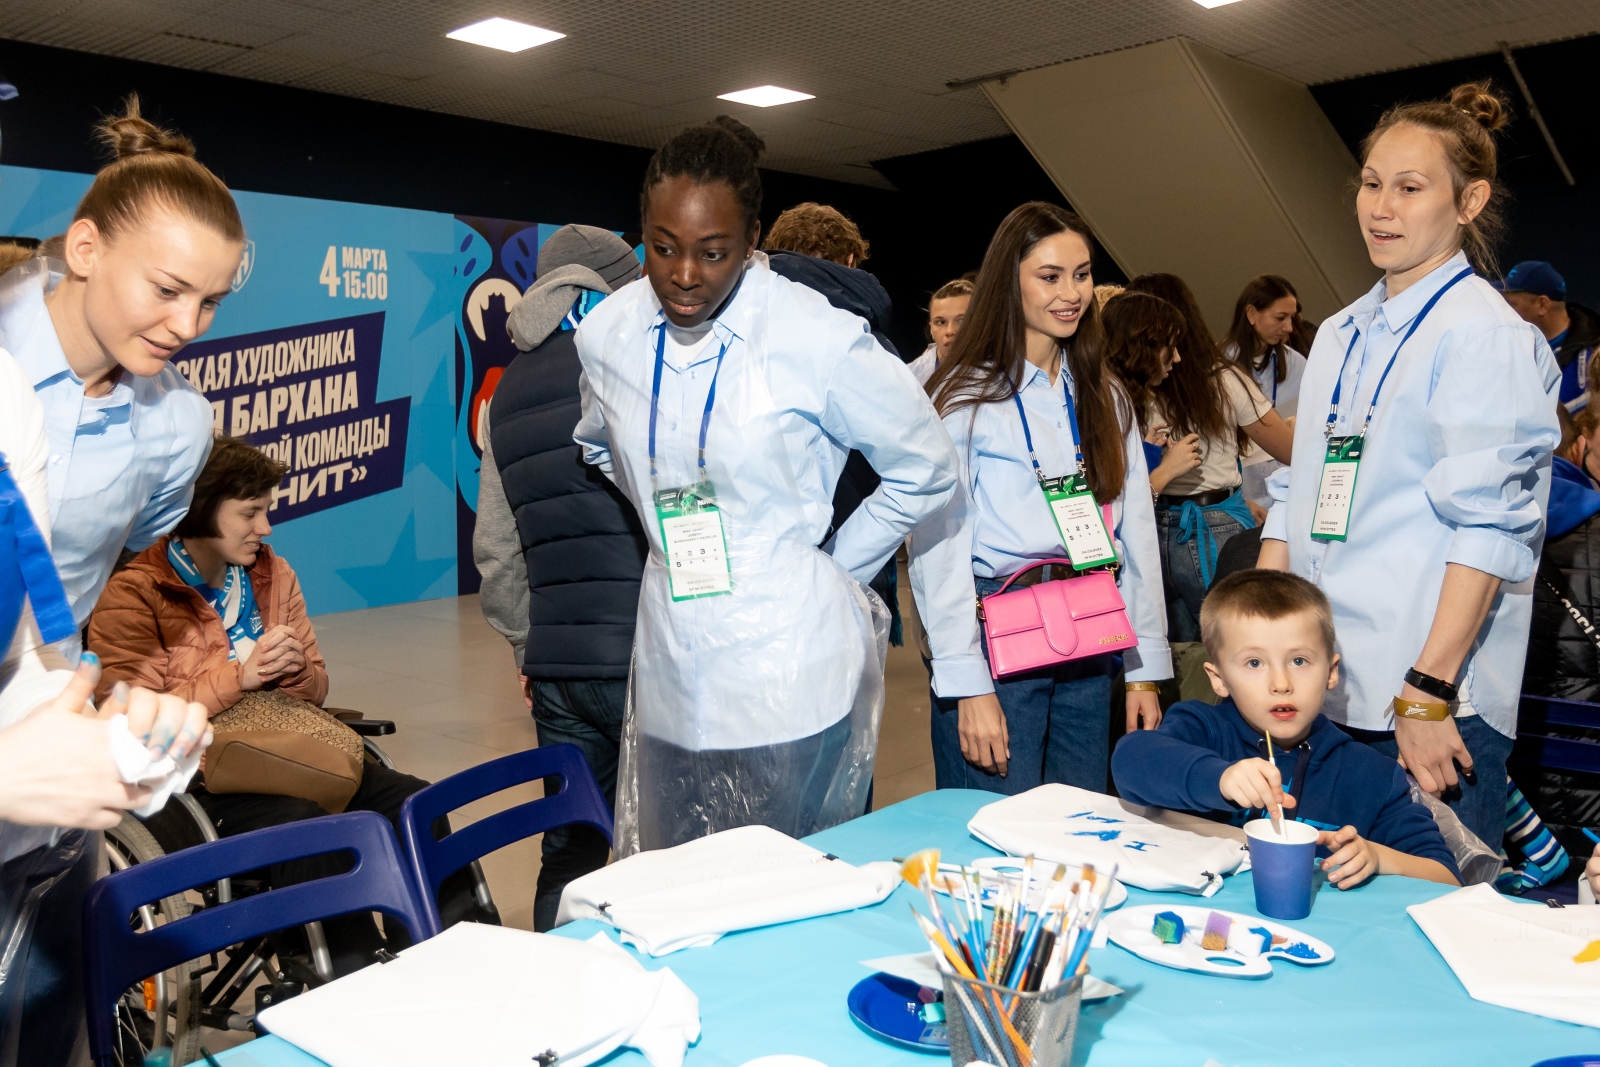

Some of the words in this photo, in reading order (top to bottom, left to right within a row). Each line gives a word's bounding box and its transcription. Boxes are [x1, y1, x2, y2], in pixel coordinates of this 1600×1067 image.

[319, 245, 341, 297] 4
[342, 246, 388, 271] МАРТА
[342, 270, 388, 300] 15:00
[233, 328, 356, 387] ХУДОЖНИКА
[230, 371, 359, 438] БАРХАНА
[295, 413, 391, 471] КОМАНДЫ
